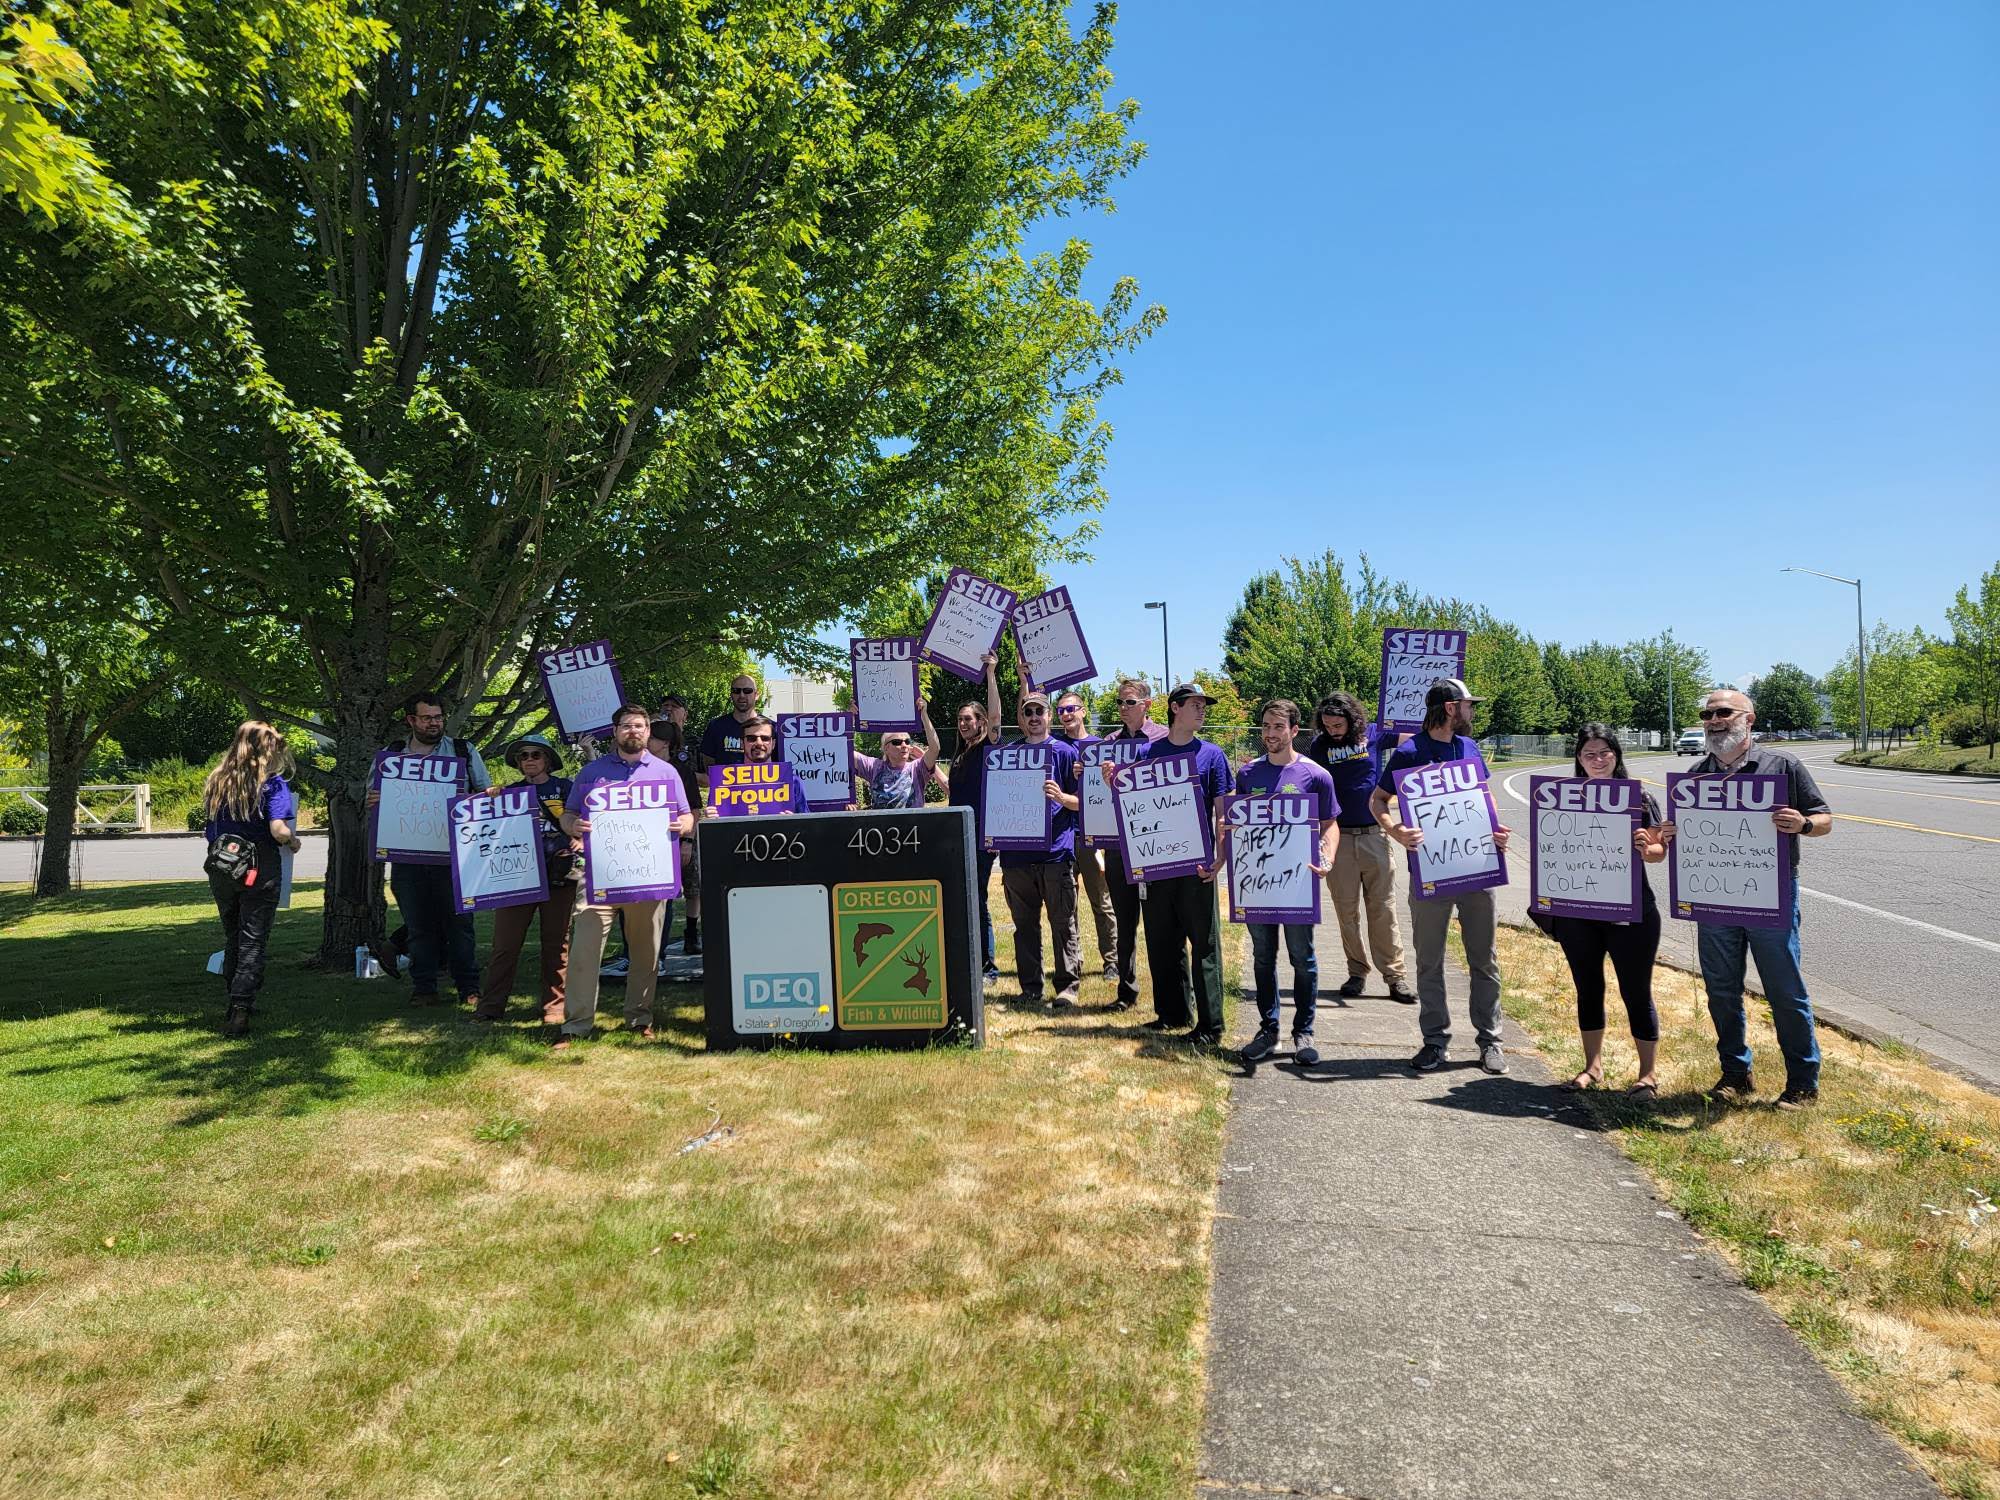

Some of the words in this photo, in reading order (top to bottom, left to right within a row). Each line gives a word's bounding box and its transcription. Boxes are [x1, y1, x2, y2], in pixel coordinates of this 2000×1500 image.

[951, 574, 1012, 612] SEIU
[1013, 591, 1065, 626] SEIU
[855, 642, 911, 660] SEIU
[1390, 632, 1459, 655] SEIU
[543, 645, 606, 674] SEIU
[1390, 655, 1410, 669] NO
[1389, 675, 1409, 686] NO
[783, 717, 845, 738] SEIU
[790, 743, 835, 767] Safety
[988, 749, 1046, 770] SEIU
[1083, 744, 1142, 766] SEIU
[383, 757, 458, 782] SEIU
[722, 765, 780, 785] SEIU
[1088, 774, 1100, 787] We
[1117, 759, 1189, 793] SEIU
[1404, 763, 1478, 799] SEIU
[590, 785, 667, 811] SEIU
[715, 784, 790, 806] Proud
[1088, 795, 1104, 806] Fair
[1123, 800, 1146, 818] We
[1153, 794, 1192, 810] Want
[1538, 781, 1630, 813] SEIU
[1676, 779, 1775, 811] SEIU
[455, 792, 528, 823] SEIU
[1232, 799, 1310, 825] SEIU
[1414, 800, 1483, 829] FAIR
[460, 824, 500, 844] Safe
[1129, 819, 1163, 836] Fair
[1540, 812, 1608, 839] COLA
[734, 832, 806, 862] 4026
[847, 825, 921, 856] 4034
[1136, 839, 1189, 857] Wages
[1423, 834, 1497, 865] WAGE
[1257, 852, 1275, 870] A
[1597, 845, 1625, 862] give
[1546, 872, 1599, 894] COLA
[844, 889, 931, 907] OREGON
[750, 978, 814, 1006] DEQ
[745, 1018, 768, 1029] State
[772, 1017, 780, 1028] of
[783, 1017, 820, 1030] Oregon
[848, 1008, 872, 1021] Fish
[878, 1009, 887, 1020] &
[891, 1006, 939, 1021] Wildlife
